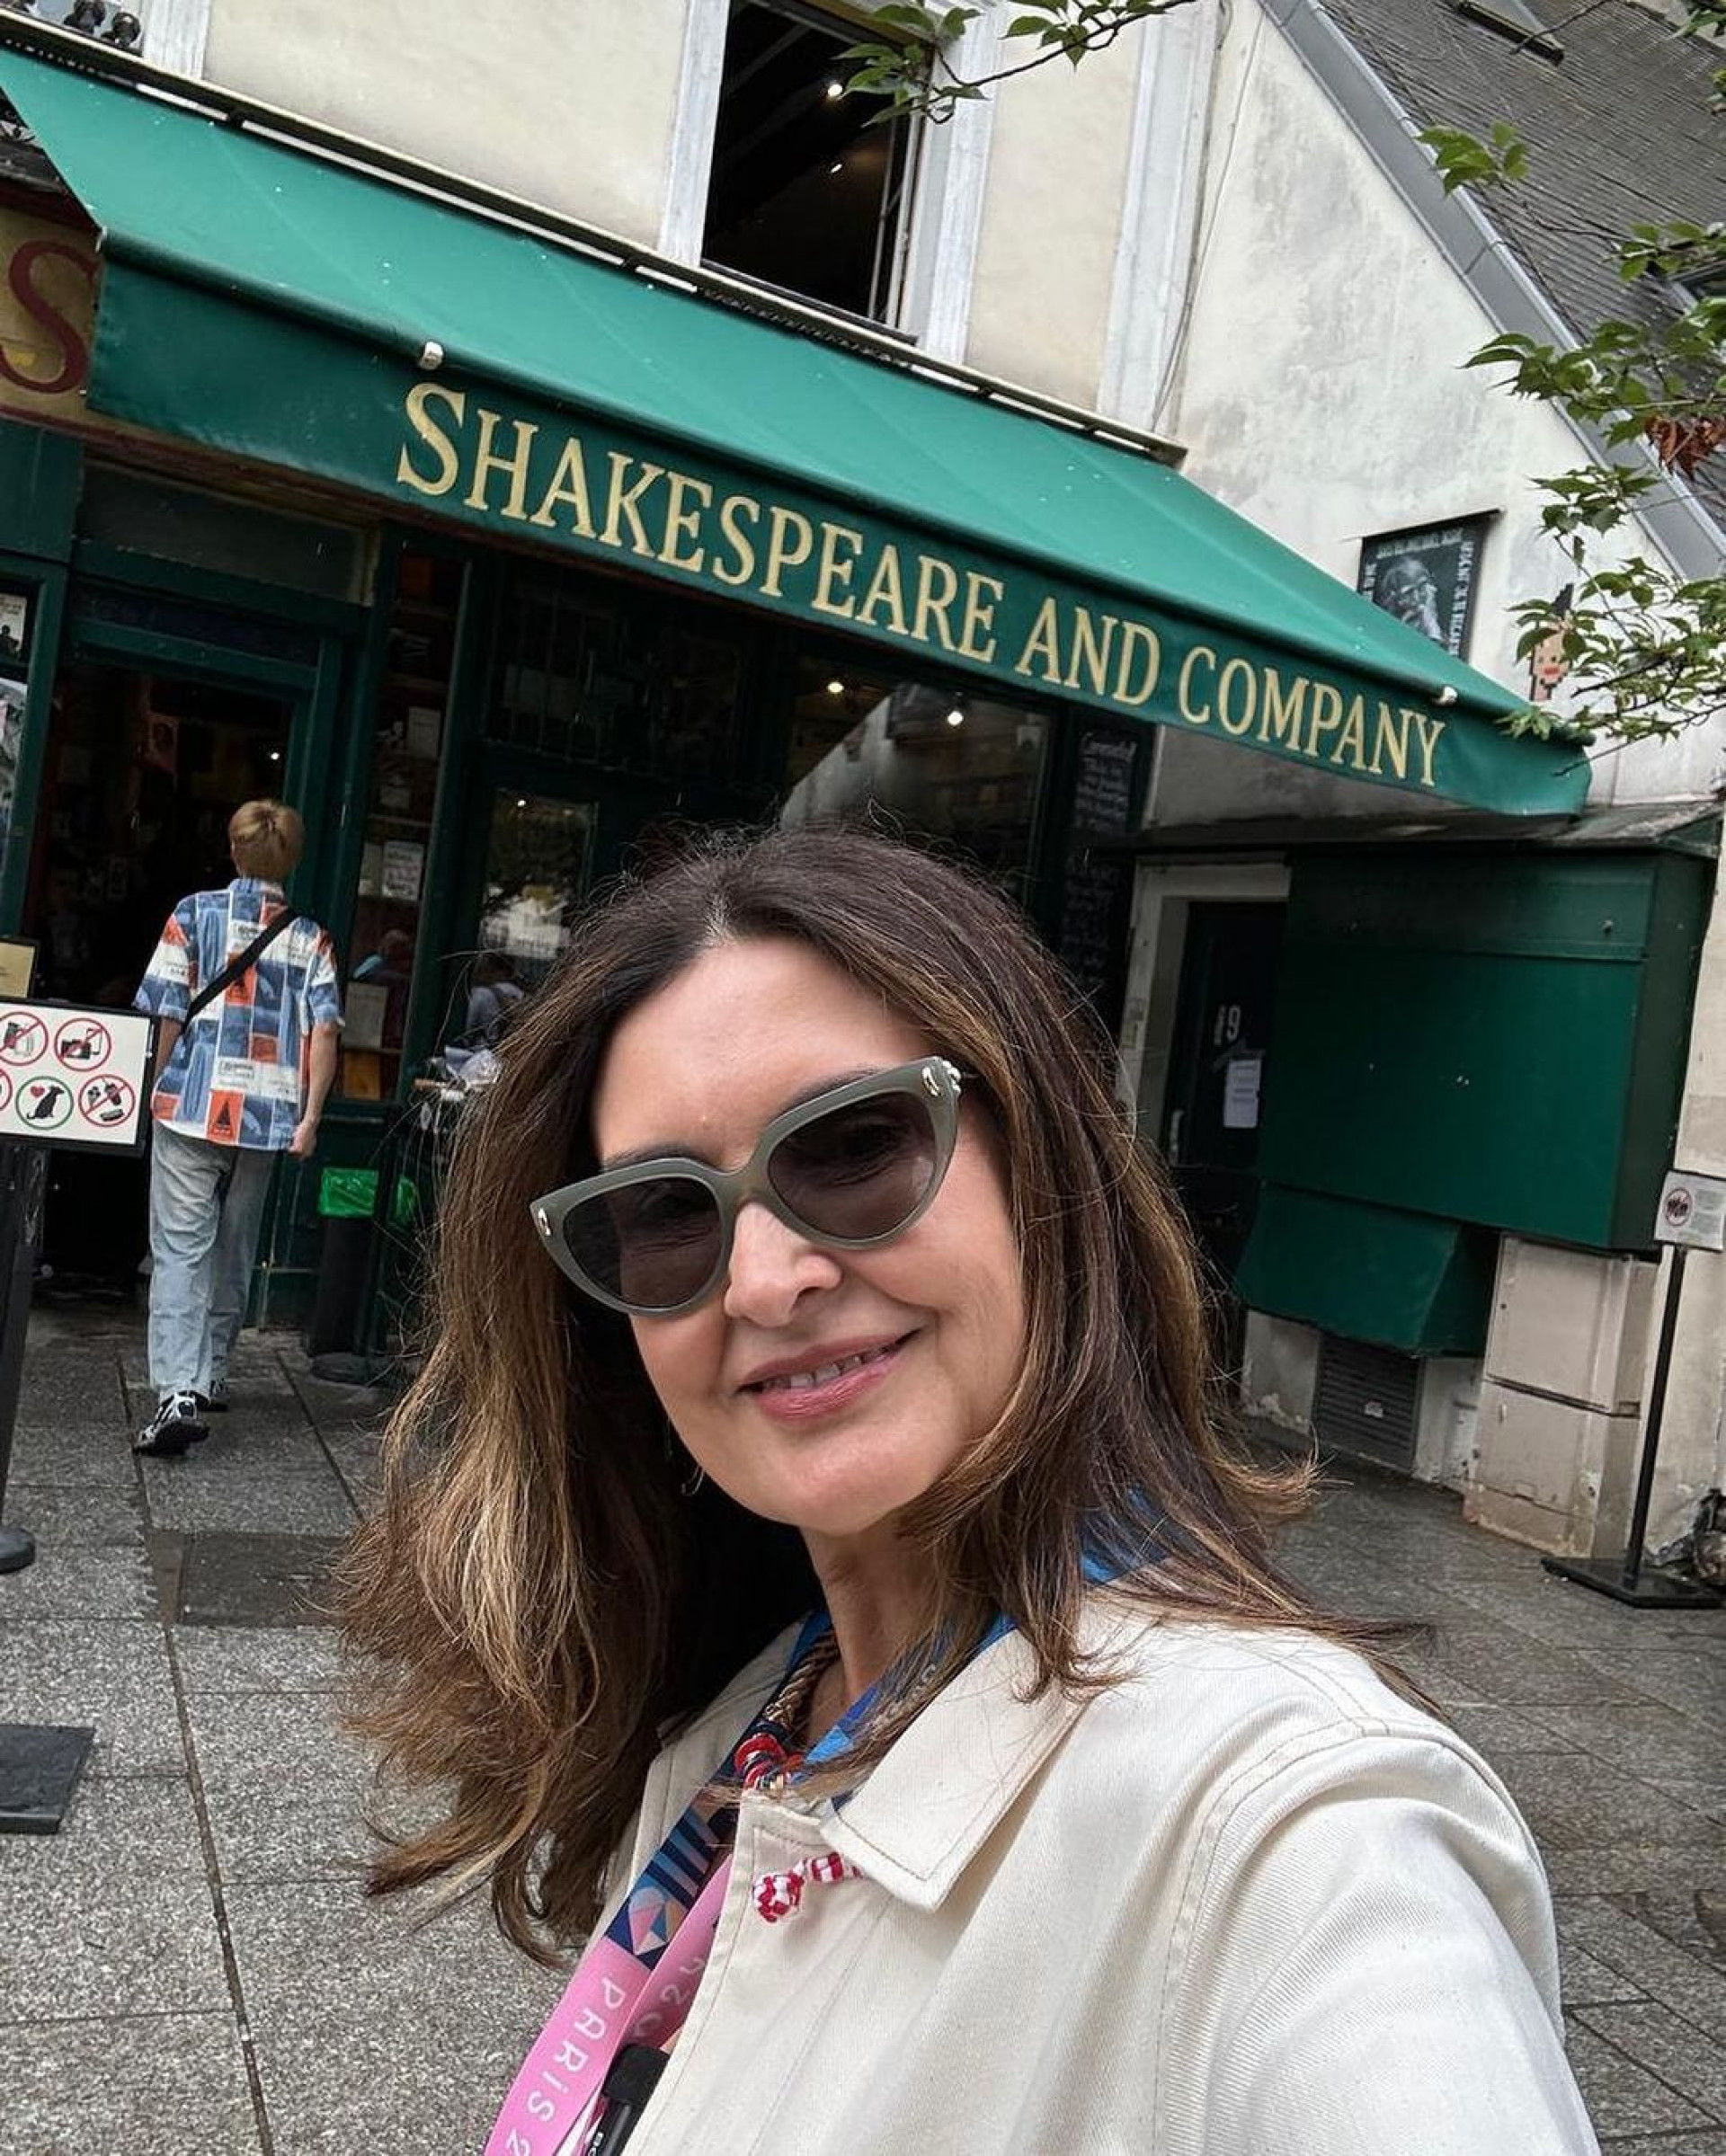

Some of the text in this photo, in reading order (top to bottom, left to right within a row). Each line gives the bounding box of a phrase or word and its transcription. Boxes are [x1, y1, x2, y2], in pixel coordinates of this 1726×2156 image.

[396, 382, 1004, 662] SHAKESPEARE
[1015, 596, 1161, 706] AND
[1179, 645, 1445, 786] COMPANY
[1214, 1004, 1241, 1046] 19
